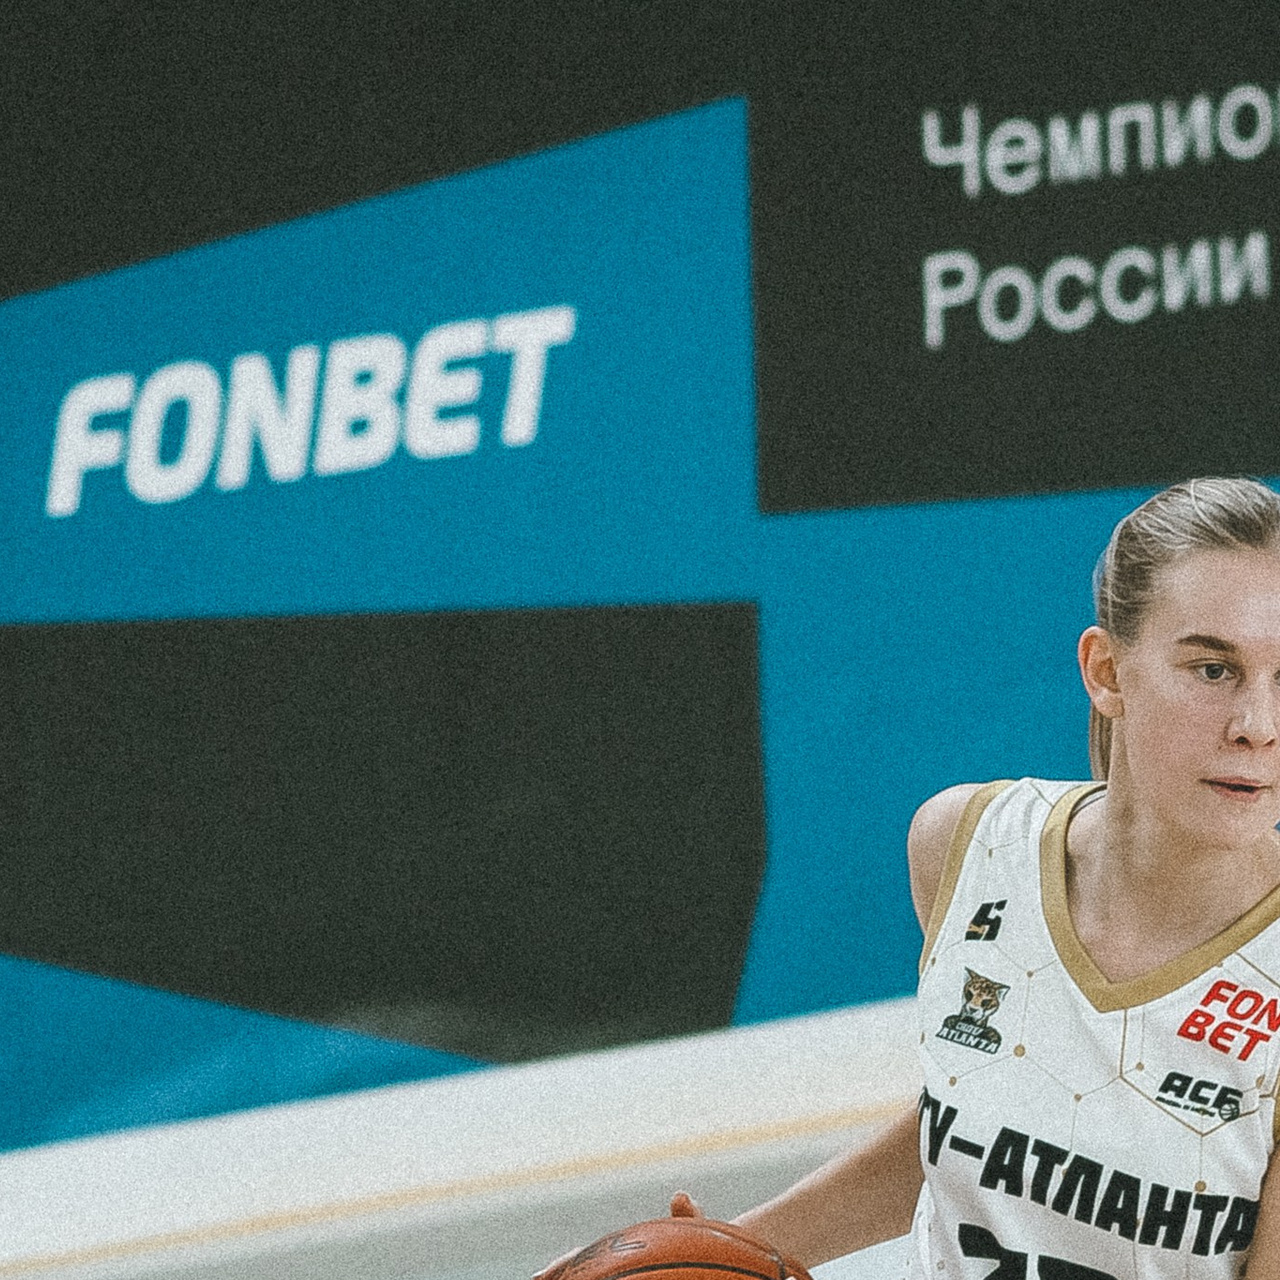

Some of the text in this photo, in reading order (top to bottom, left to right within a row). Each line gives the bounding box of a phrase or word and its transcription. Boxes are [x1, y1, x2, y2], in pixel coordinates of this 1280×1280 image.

[922, 229, 1271, 351] России
[45, 304, 578, 518] FONBET
[939, 1026, 998, 1053] ATLANTA
[1176, 1008, 1271, 1062] BET
